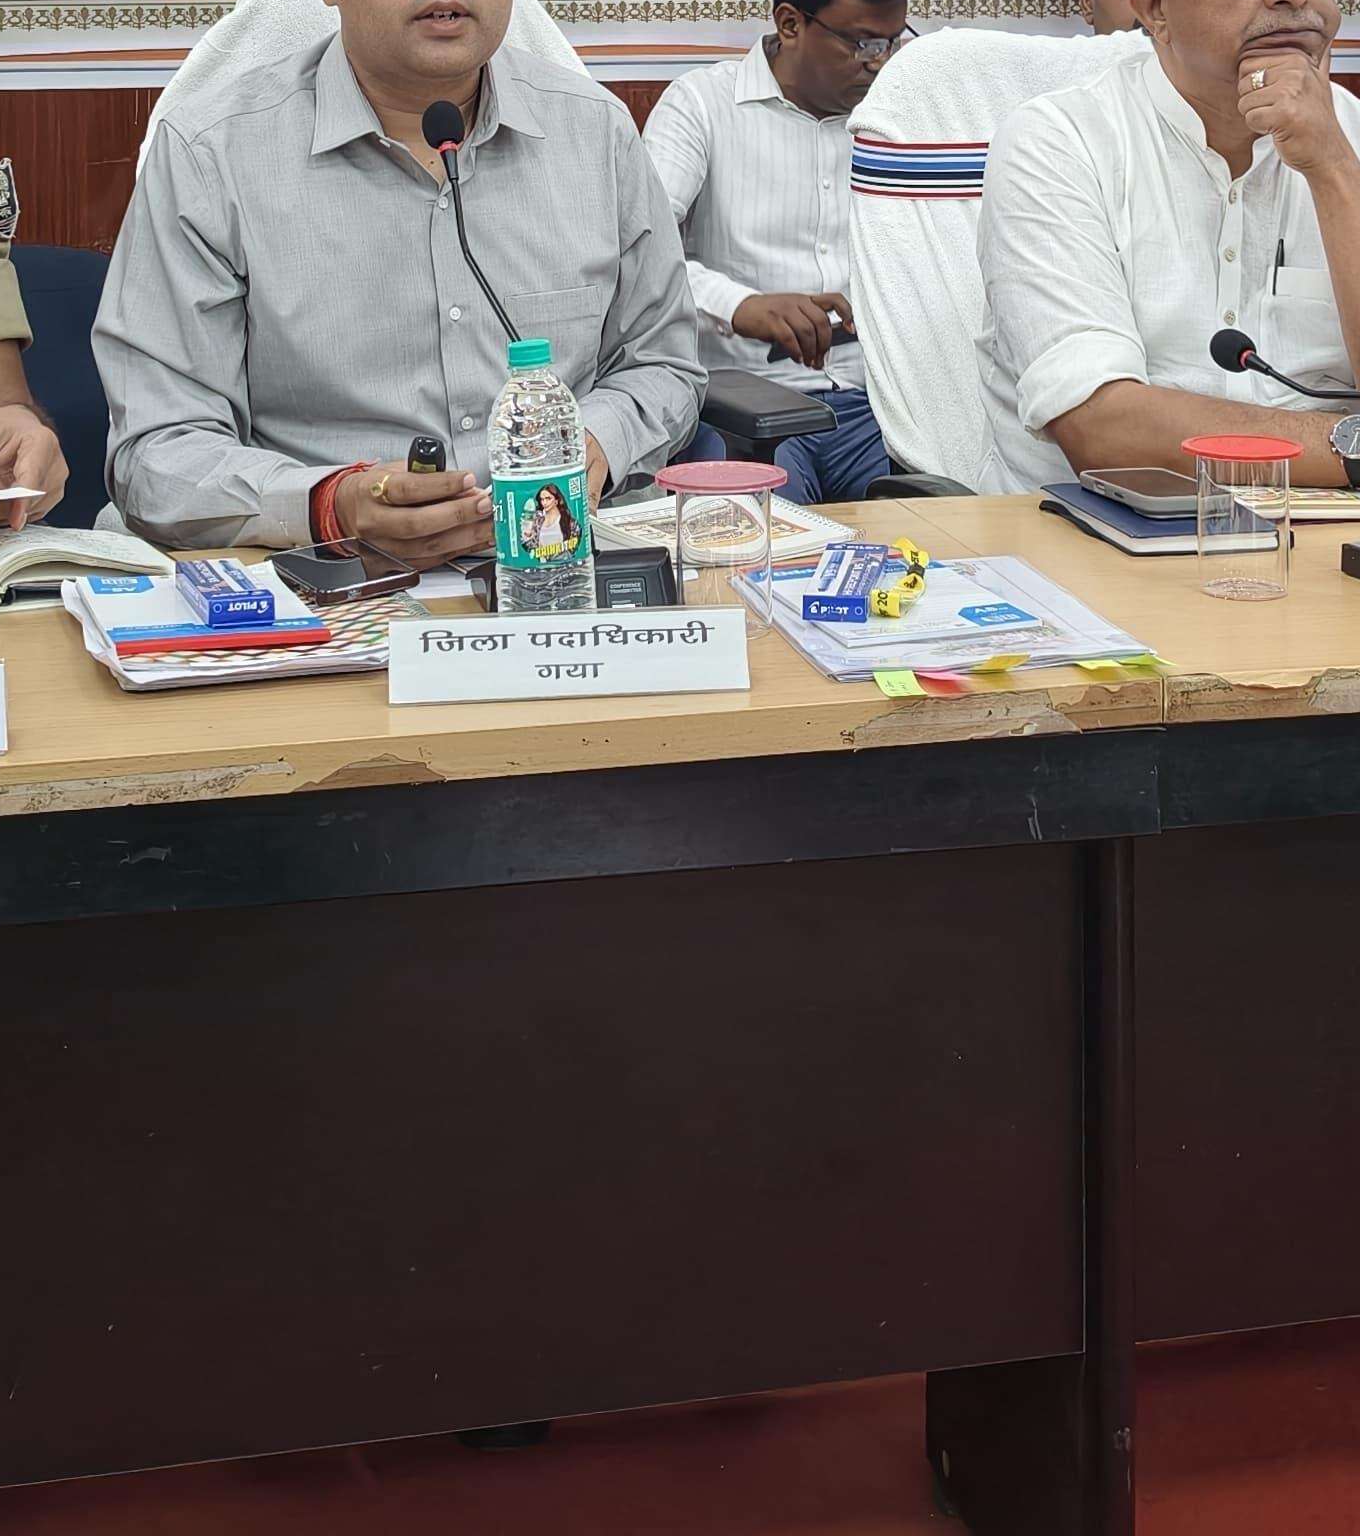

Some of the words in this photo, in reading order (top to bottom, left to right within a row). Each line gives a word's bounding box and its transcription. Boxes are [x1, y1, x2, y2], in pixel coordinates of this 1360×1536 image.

[227, 601, 258, 612] PILOT
[820, 605, 849, 615] PILOT
[419, 630, 516, 654] जिला
[528, 621, 716, 649] पदाधिकारी
[535, 662, 605, 680] गया
